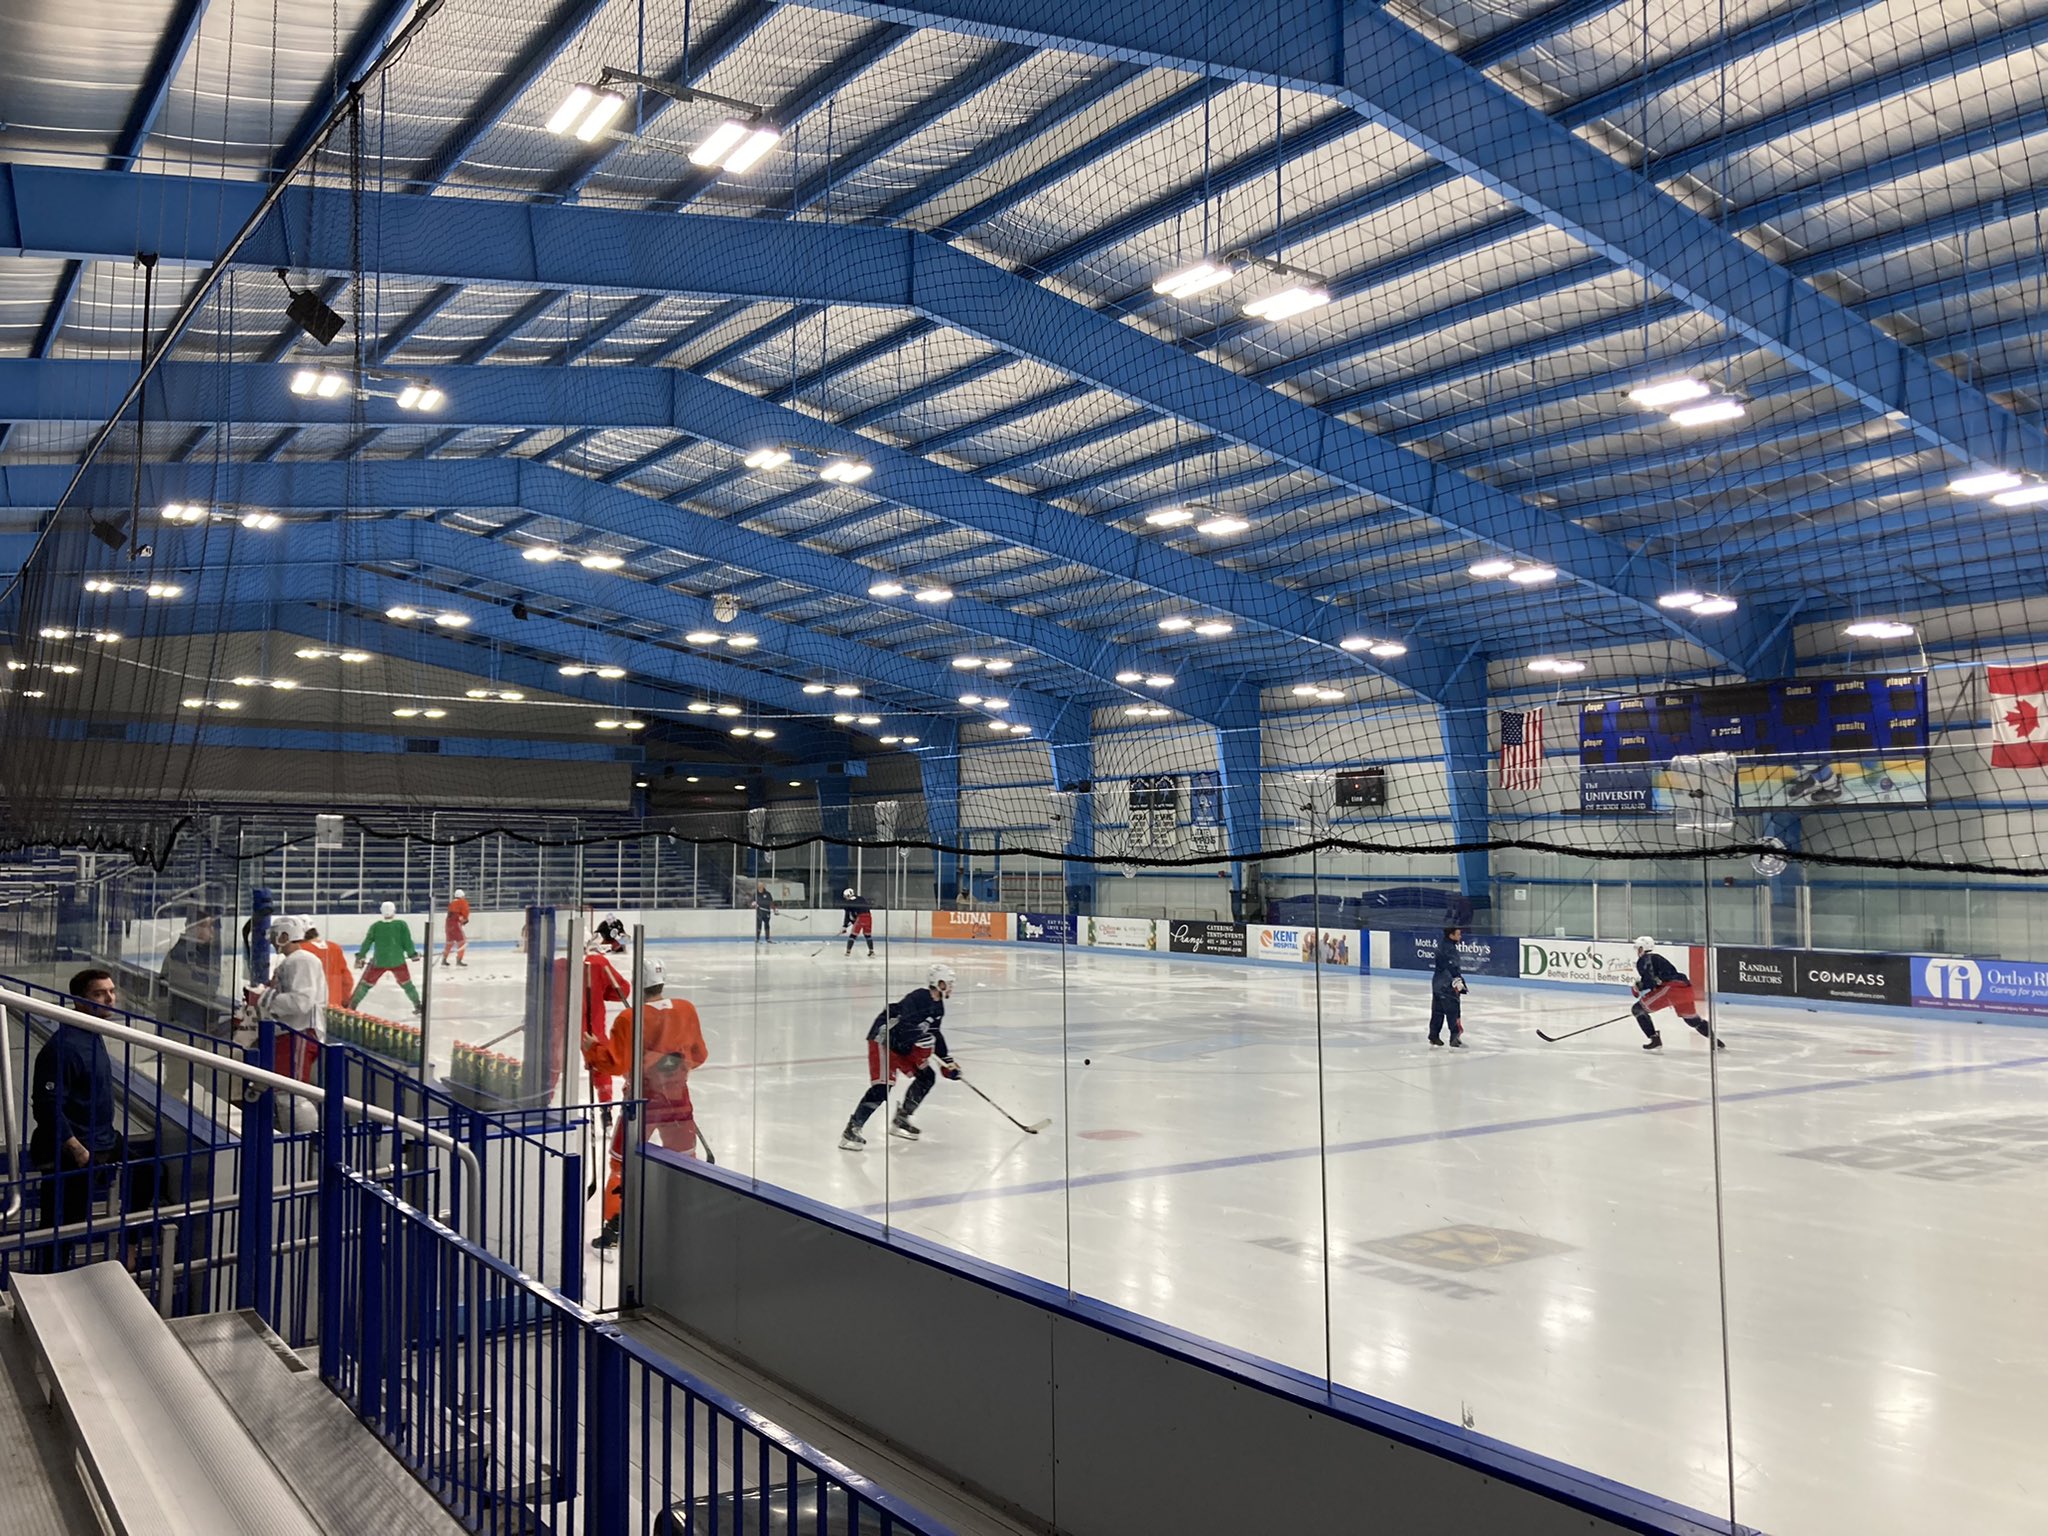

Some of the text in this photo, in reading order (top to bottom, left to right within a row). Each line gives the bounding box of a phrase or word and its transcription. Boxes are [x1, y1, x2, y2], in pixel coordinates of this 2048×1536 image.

[1835, 681, 1865, 692] penalty
[1886, 677, 1912, 688] player
[1786, 687, 1812, 696] Guests
[1584, 703, 1605, 713] player
[1836, 721, 1866, 732] penalty
[1889, 718, 1917, 729] player
[1719, 725, 1742, 736] period
[1583, 739, 1603, 748] player
[1584, 790, 1647, 802] UNIVERSITY
[1206, 924, 1234, 932] CATERING
[1273, 930, 1298, 943] KENT
[1273, 942, 1298, 950] HOSPITAL
[1415, 938, 1439, 949] Mott &
[1520, 944, 1604, 976] Dave's
[1739, 961, 1782, 974] RANDALL
[1547, 969, 1569, 979] Better
[1597, 973, 1619, 982] Better
[1808, 969, 1885, 987] COMPASS
[1987, 968, 2032, 986] Ortho
[1989, 985, 2017, 997] Caring
[2018, 986, 2030, 997] for
